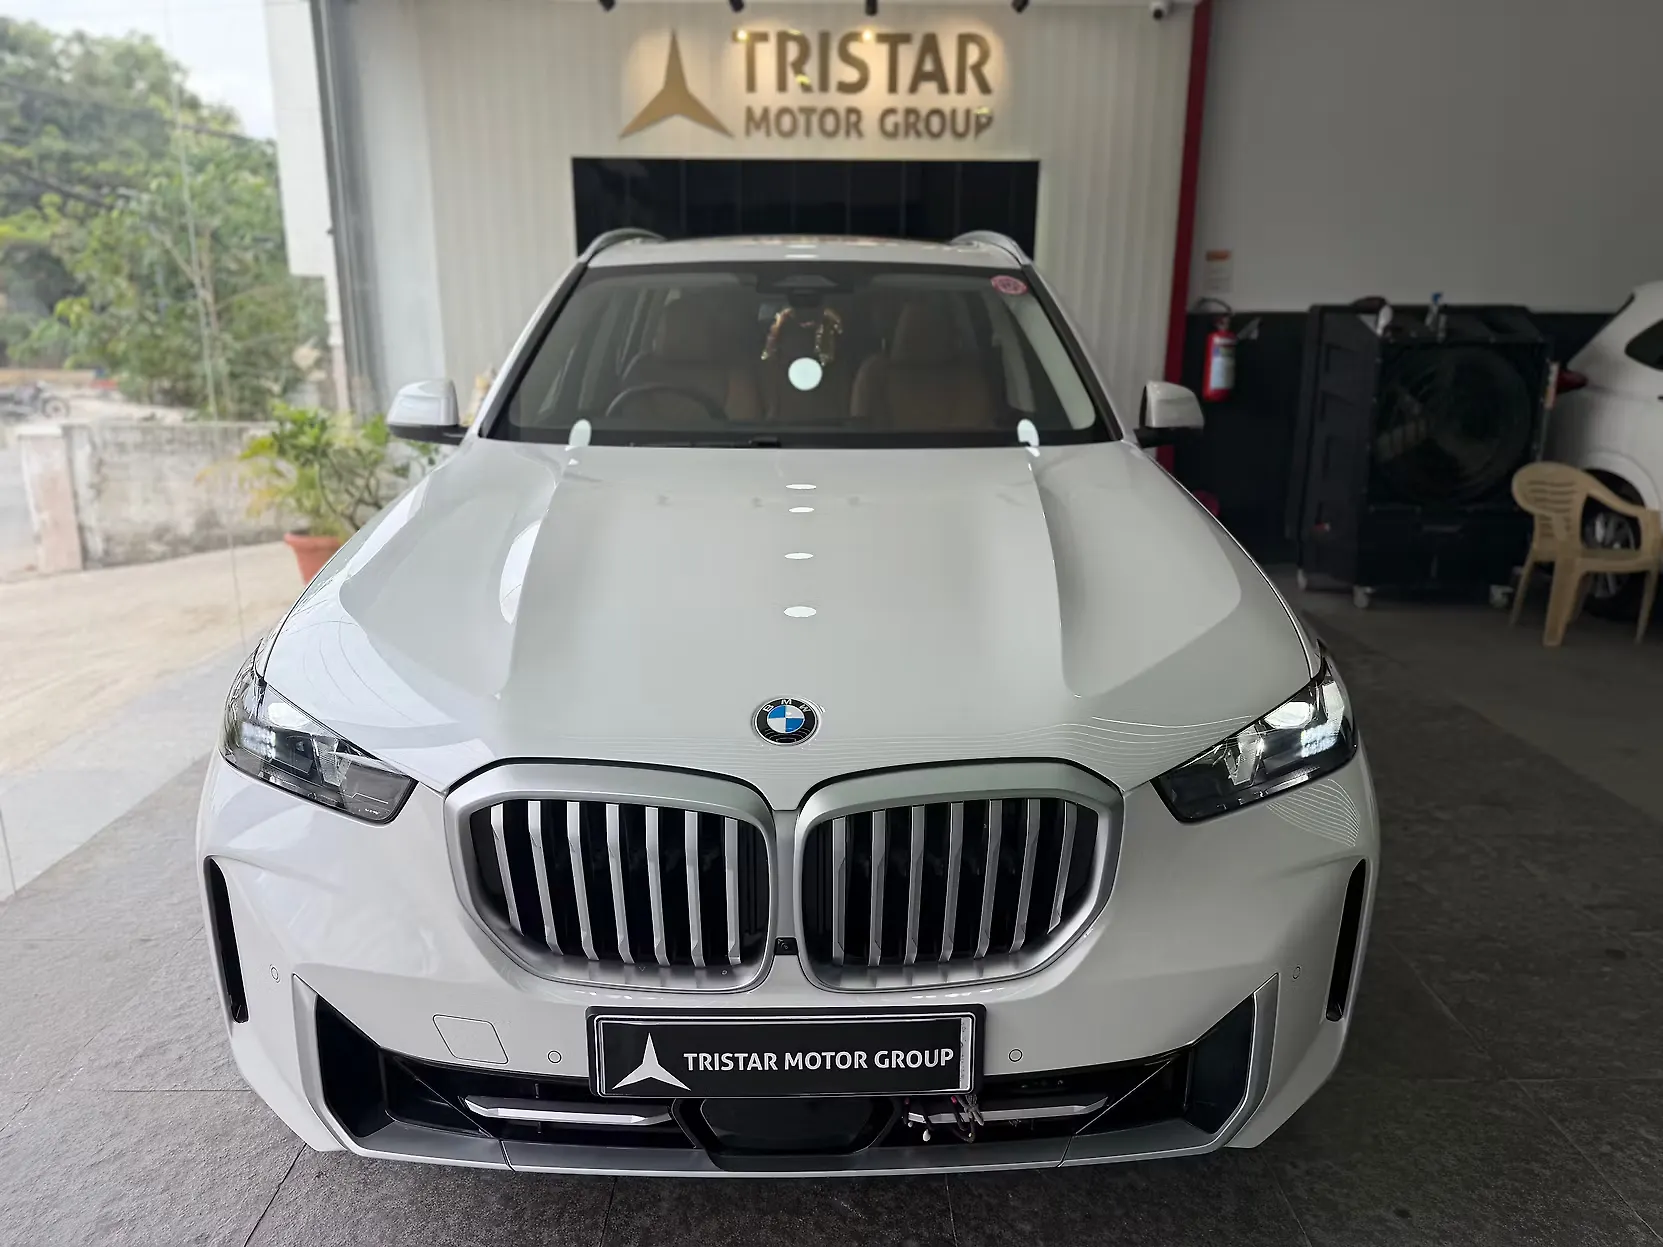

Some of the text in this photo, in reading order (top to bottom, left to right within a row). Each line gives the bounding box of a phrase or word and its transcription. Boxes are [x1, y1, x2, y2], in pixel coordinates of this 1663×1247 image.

[732, 31, 993, 96] TRISTAR
[745, 106, 993, 140] MOTOR GROUP
[762, 699, 812, 713] BMW
[683, 1049, 954, 1072] TRISTAR MOTOR GROUP
